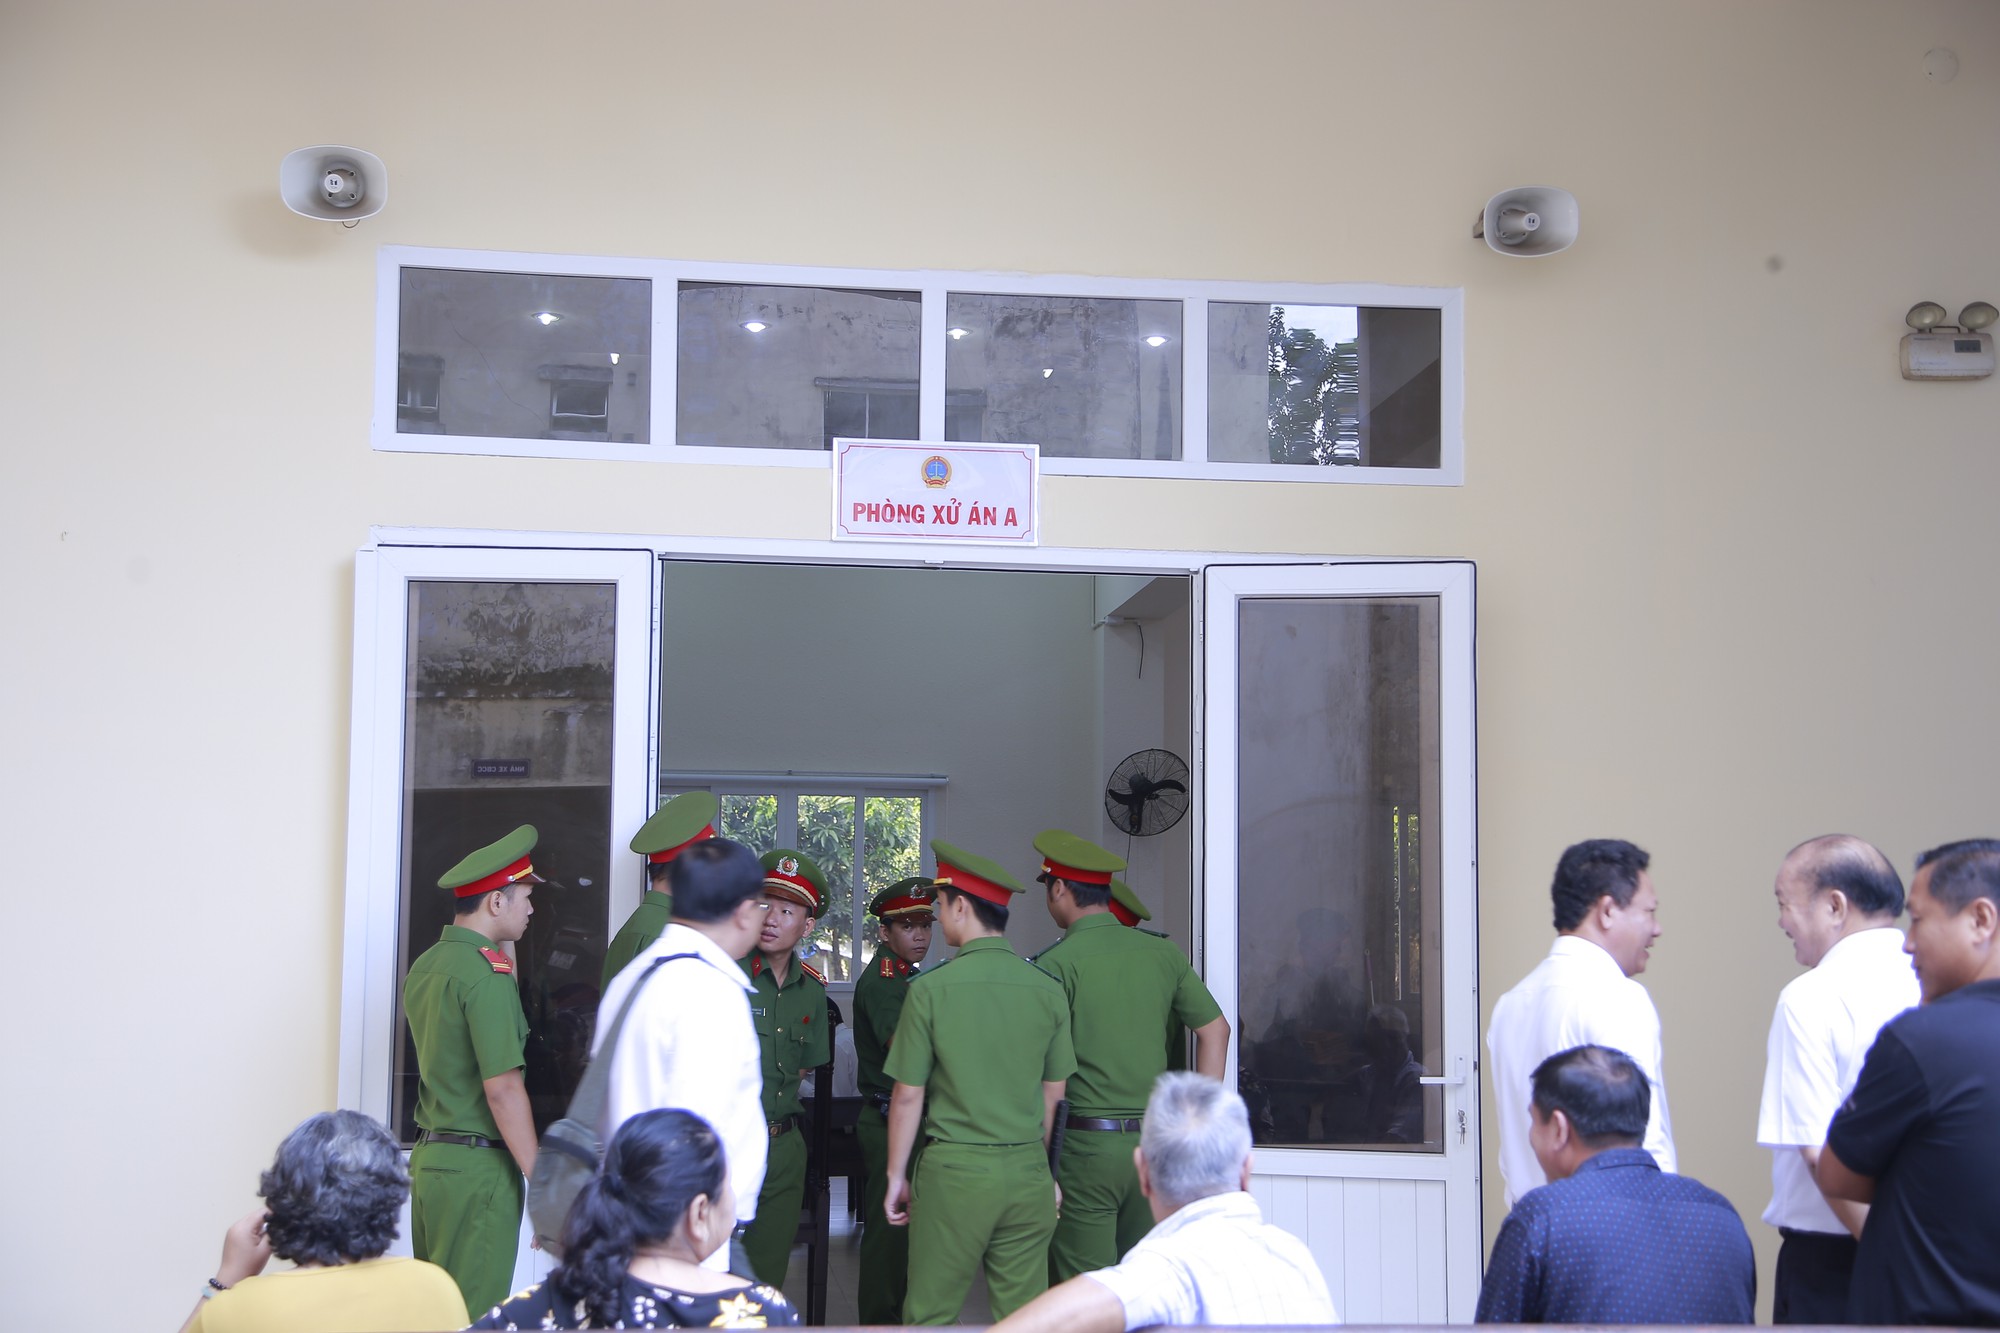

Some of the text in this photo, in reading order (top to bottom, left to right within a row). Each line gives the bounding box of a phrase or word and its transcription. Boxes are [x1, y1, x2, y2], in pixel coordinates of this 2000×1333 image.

[853, 497, 1018, 527] PHÒNG XỬ ÁN A
